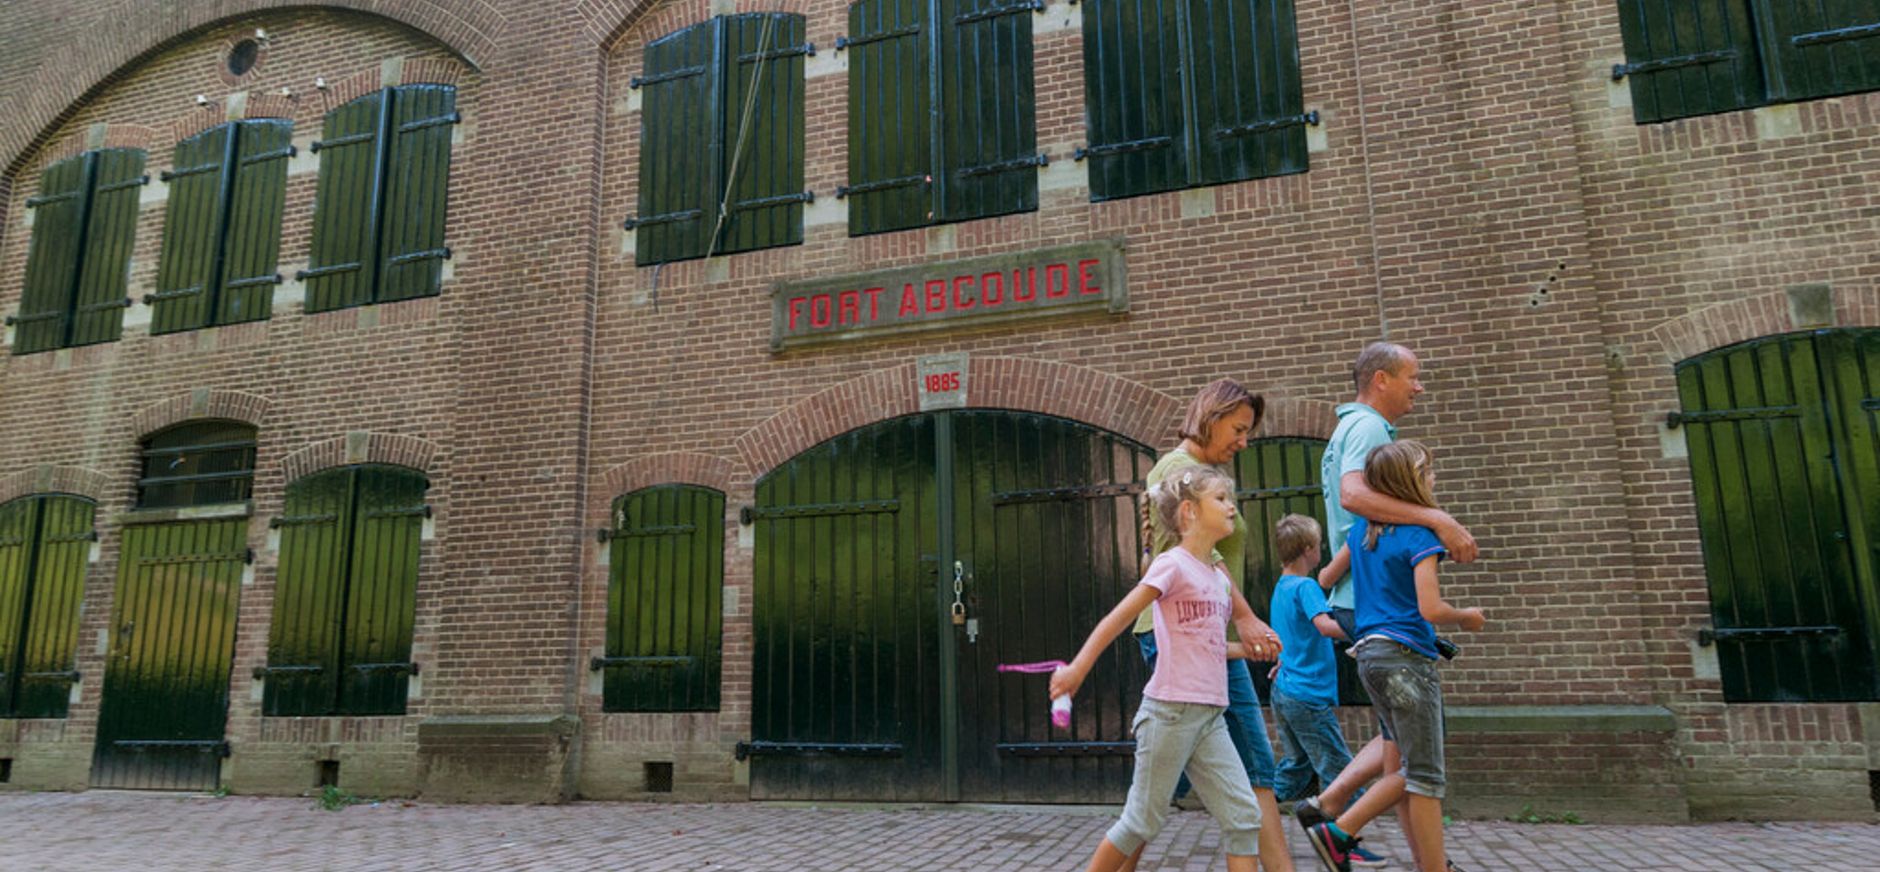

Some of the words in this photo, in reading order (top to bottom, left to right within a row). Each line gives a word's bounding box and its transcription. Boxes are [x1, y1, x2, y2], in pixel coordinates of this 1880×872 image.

[788, 287, 885, 331] FORT
[898, 258, 1102, 318] ABCOUDE
[924, 371, 961, 393] 1885
